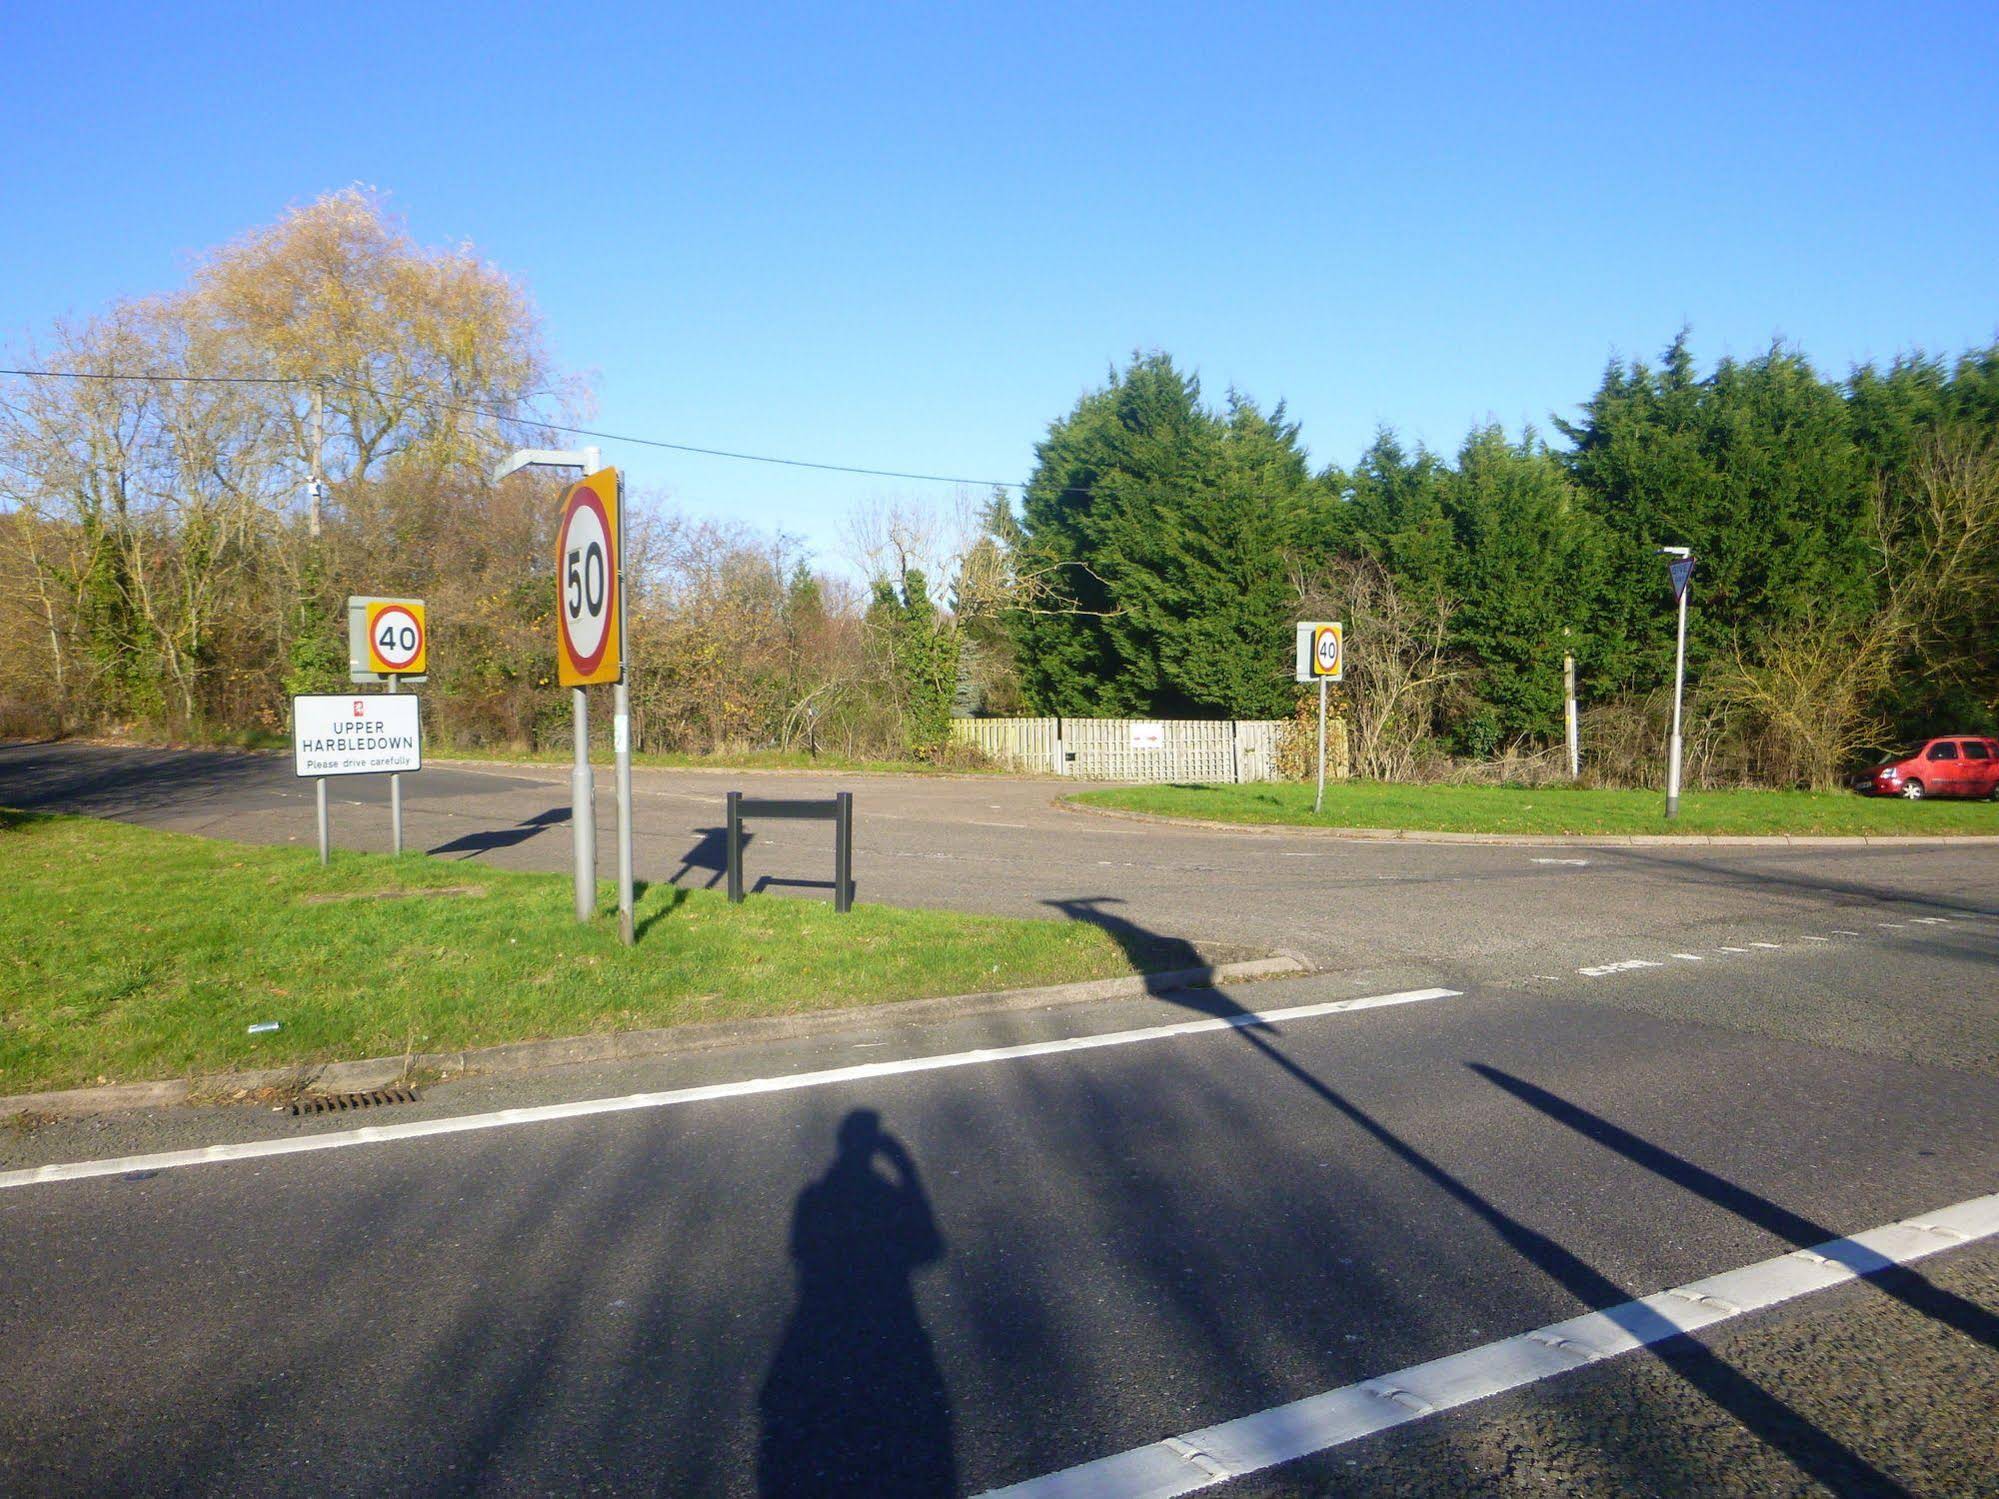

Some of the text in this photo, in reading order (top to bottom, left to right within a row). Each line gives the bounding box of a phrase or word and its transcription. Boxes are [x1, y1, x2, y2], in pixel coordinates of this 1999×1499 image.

[568, 541, 604, 618] 50
[379, 626, 416, 651] 40
[1319, 642, 1336, 659] 40
[333, 721, 384, 735] UPPER
[303, 737, 413, 753] HARBLEDOWN
[307, 755, 410, 769] Please drive carefully
